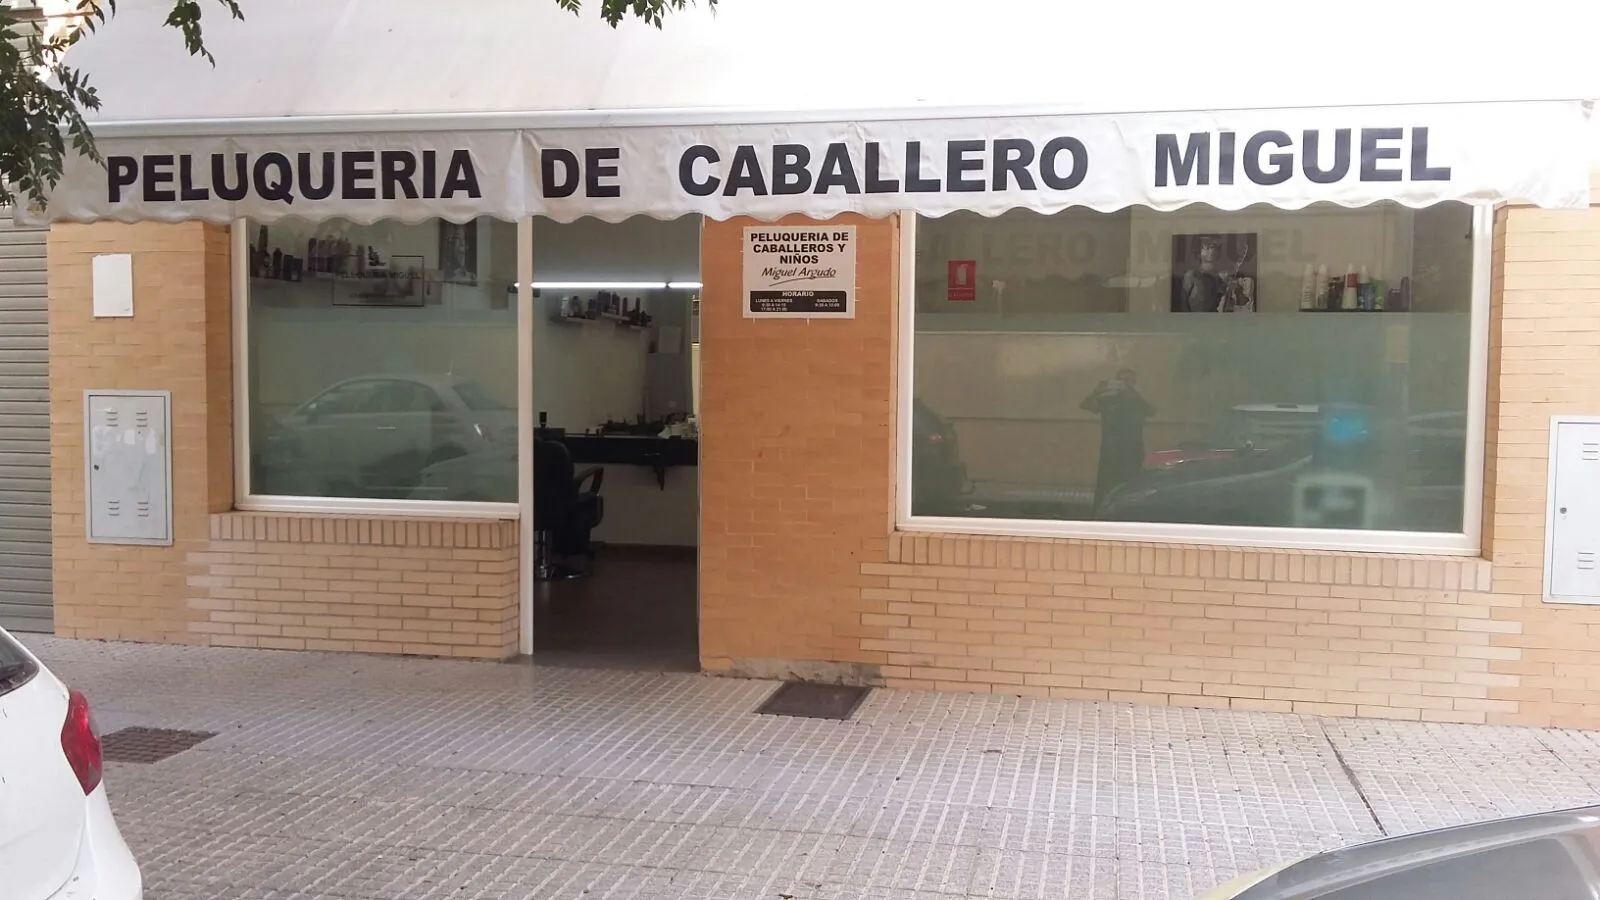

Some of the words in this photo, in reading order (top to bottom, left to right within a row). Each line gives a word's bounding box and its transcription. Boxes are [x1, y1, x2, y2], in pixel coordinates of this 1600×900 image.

[107, 149, 482, 205] PELUQUERIA
[540, 148, 621, 198] DE
[678, 136, 1089, 197] CABALLERO
[1154, 126, 1451, 187] MIGUEL
[750, 232, 829, 242] PELUQUERIA
[832, 231, 849, 242] DE
[753, 243, 834, 253] CABALLEROS
[837, 243, 846, 252] Y
[780, 253, 819, 264] NIÑOS
[761, 266, 798, 280] Miguel
[797, 266, 837, 280] Argudo
